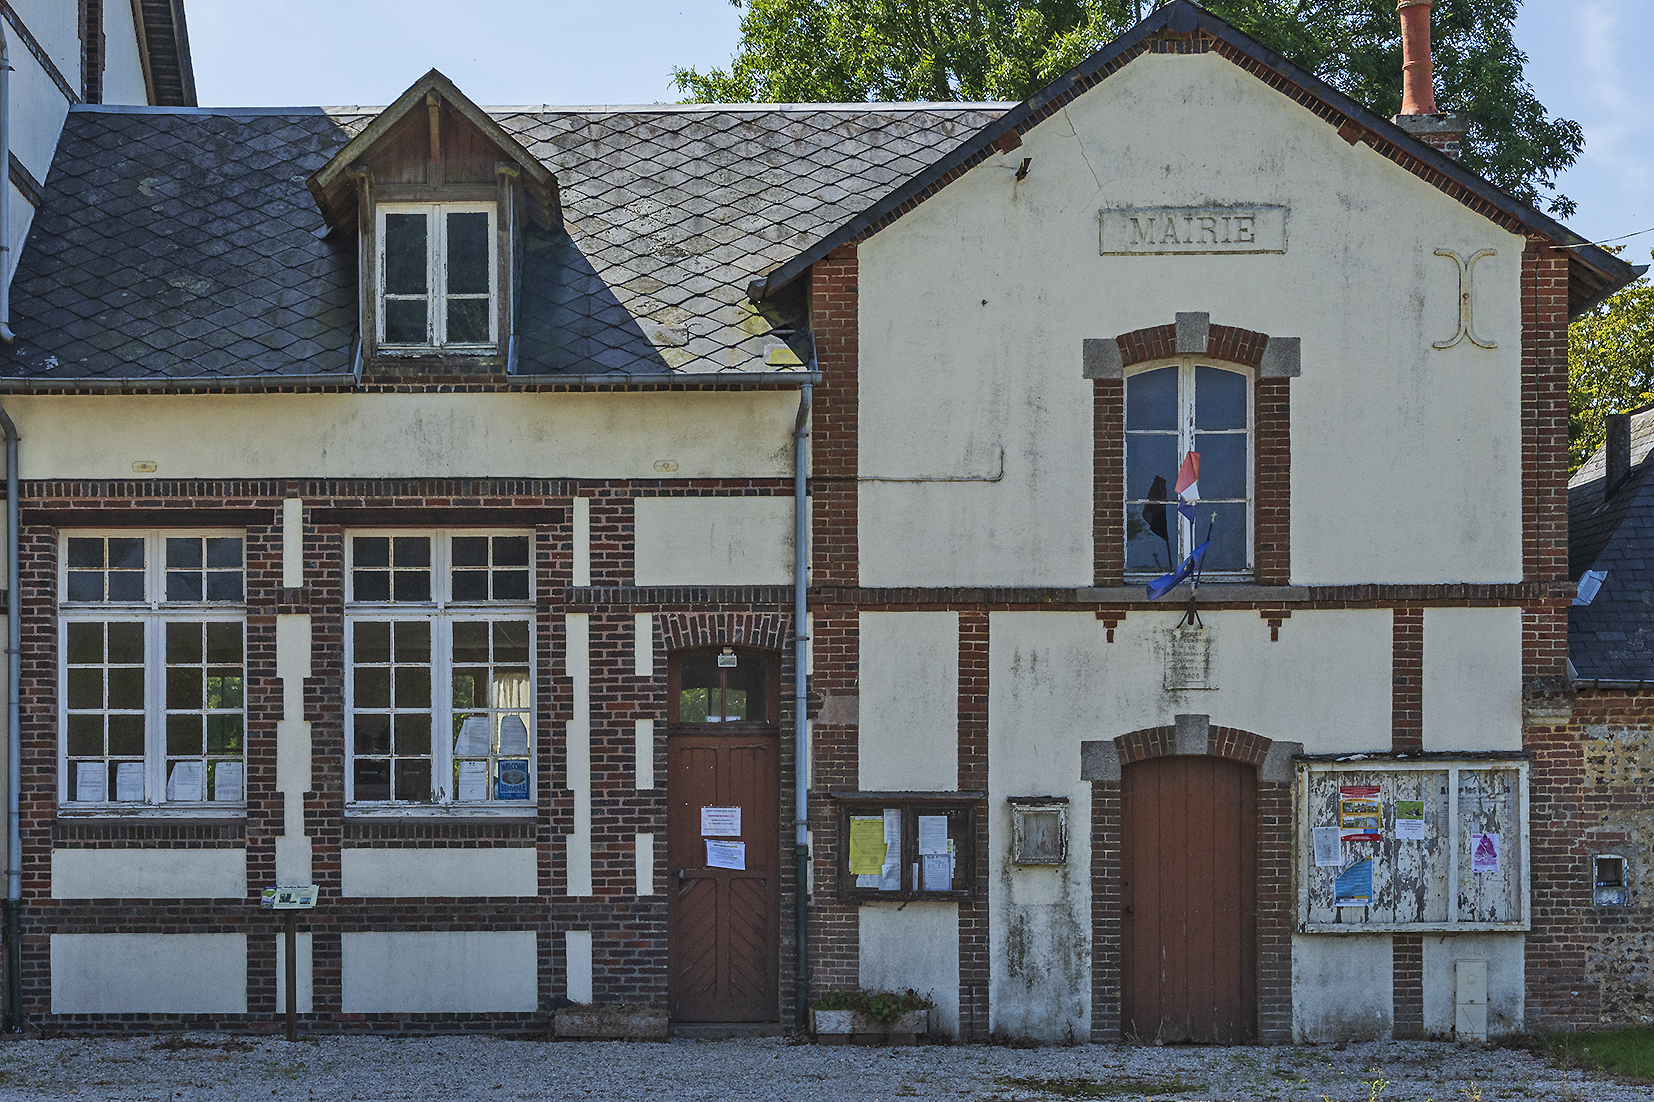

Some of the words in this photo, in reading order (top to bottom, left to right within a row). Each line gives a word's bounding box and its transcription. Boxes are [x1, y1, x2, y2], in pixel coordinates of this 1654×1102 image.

[1130, 216, 1255, 245] MAIRIE
[500, 762, 526, 772] WELCOME
[501, 783, 526, 792] BIENVENUE
